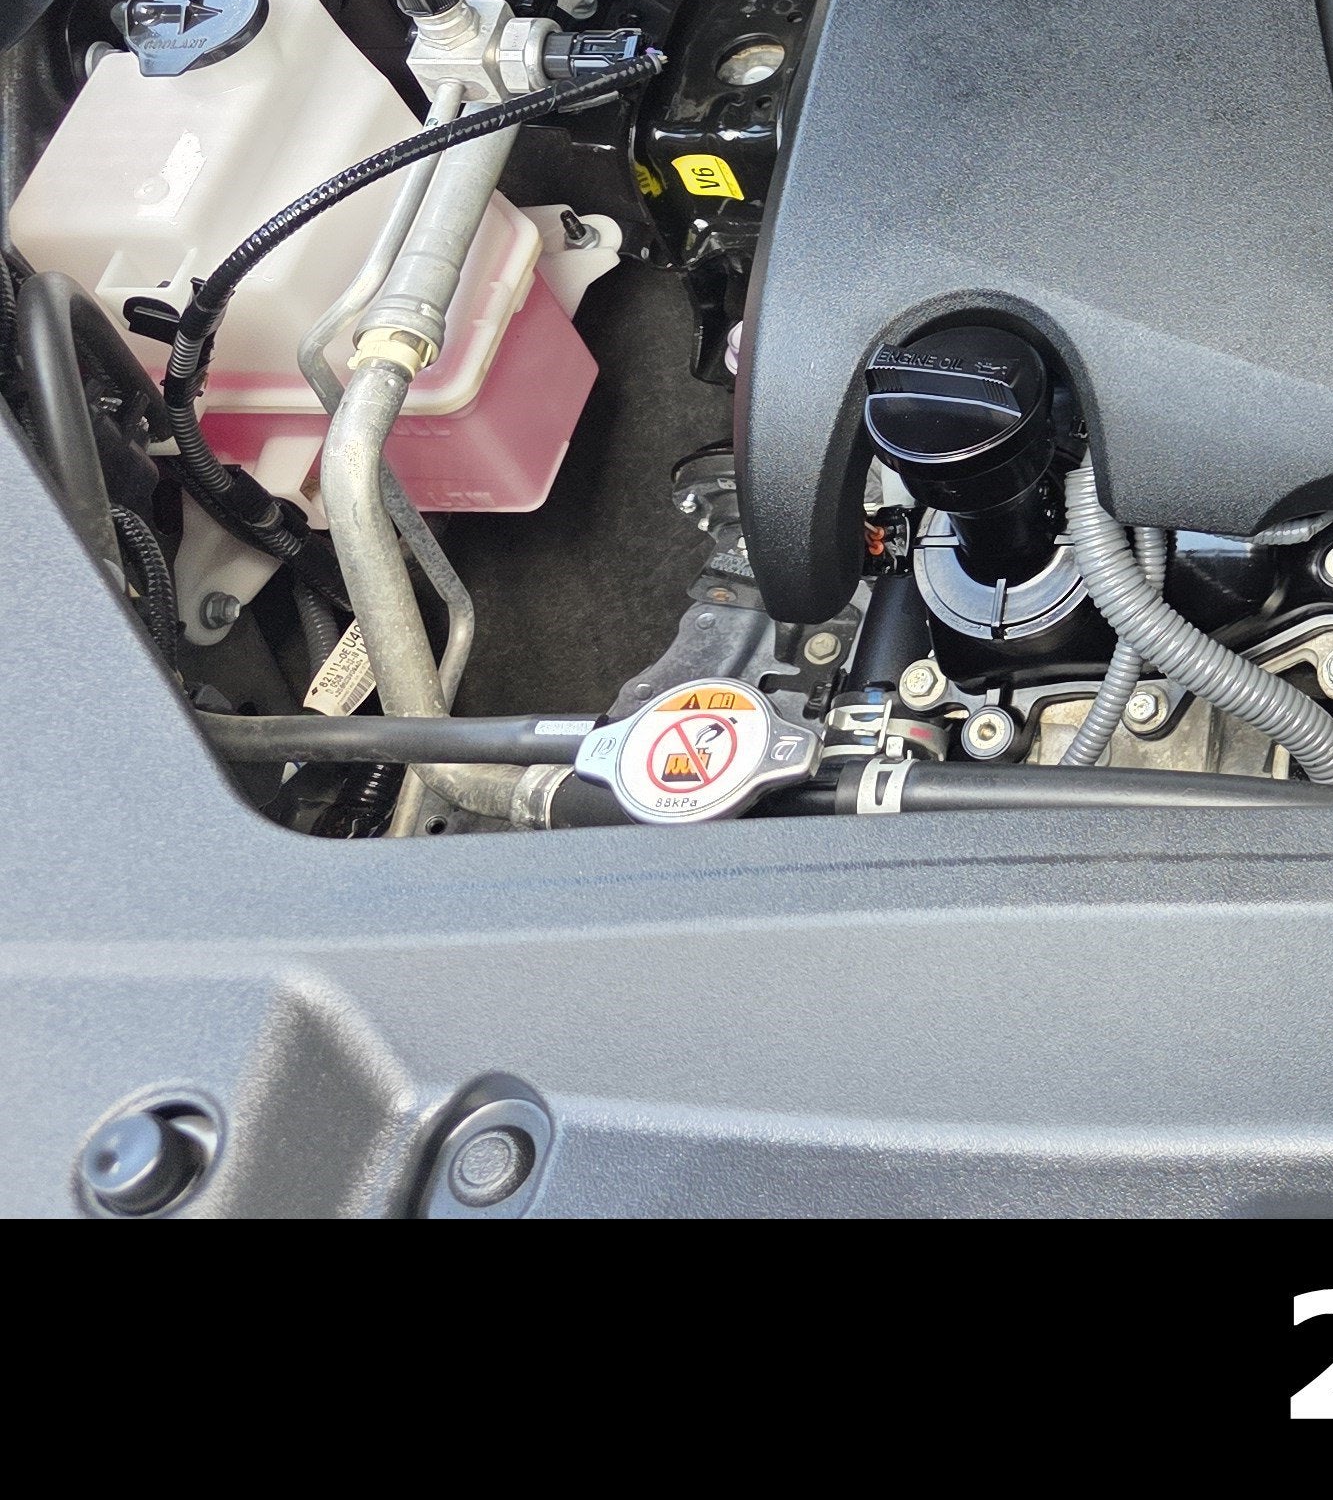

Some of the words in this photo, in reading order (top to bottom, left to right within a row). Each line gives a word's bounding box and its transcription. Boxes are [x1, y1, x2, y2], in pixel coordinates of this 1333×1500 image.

[691, 167, 721, 190] V6
[876, 351, 938, 368] ENGINE
[938, 357, 963, 371] OIL
[655, 796, 698, 808] 88kPa
